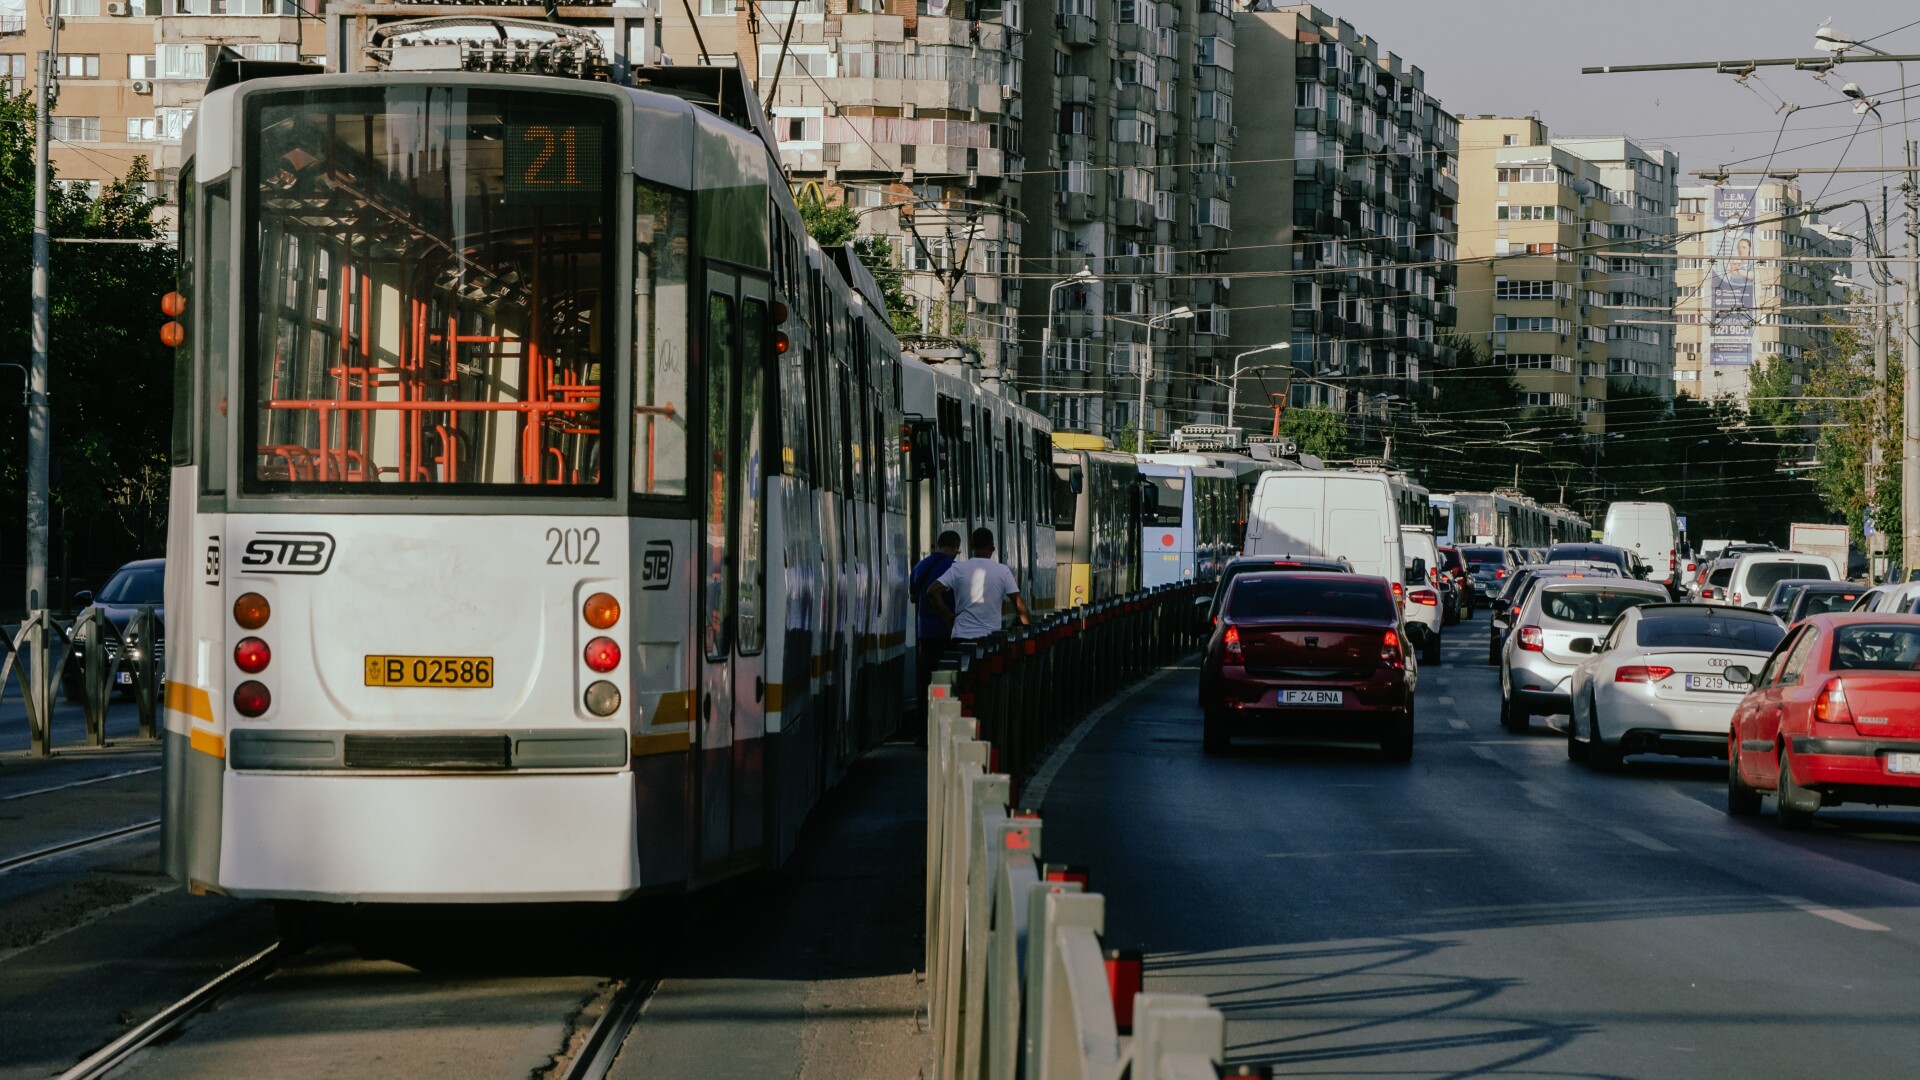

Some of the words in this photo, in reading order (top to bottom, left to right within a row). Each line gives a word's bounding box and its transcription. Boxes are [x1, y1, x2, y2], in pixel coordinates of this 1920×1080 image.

[524, 125, 582, 184] 21
[1717, 201, 1752, 209] MEDICAL
[241, 538, 327, 567] STB
[546, 527, 600, 565] 202
[642, 546, 670, 584] STB
[386, 659, 405, 682] B
[413, 659, 490, 683] 02586
[1692, 676, 1701, 687] B
[1705, 677, 1723, 689] 219
[1286, 691, 1297, 702] IF
[1301, 691, 1314, 702] 24
[1317, 691, 1339, 702] BNA
